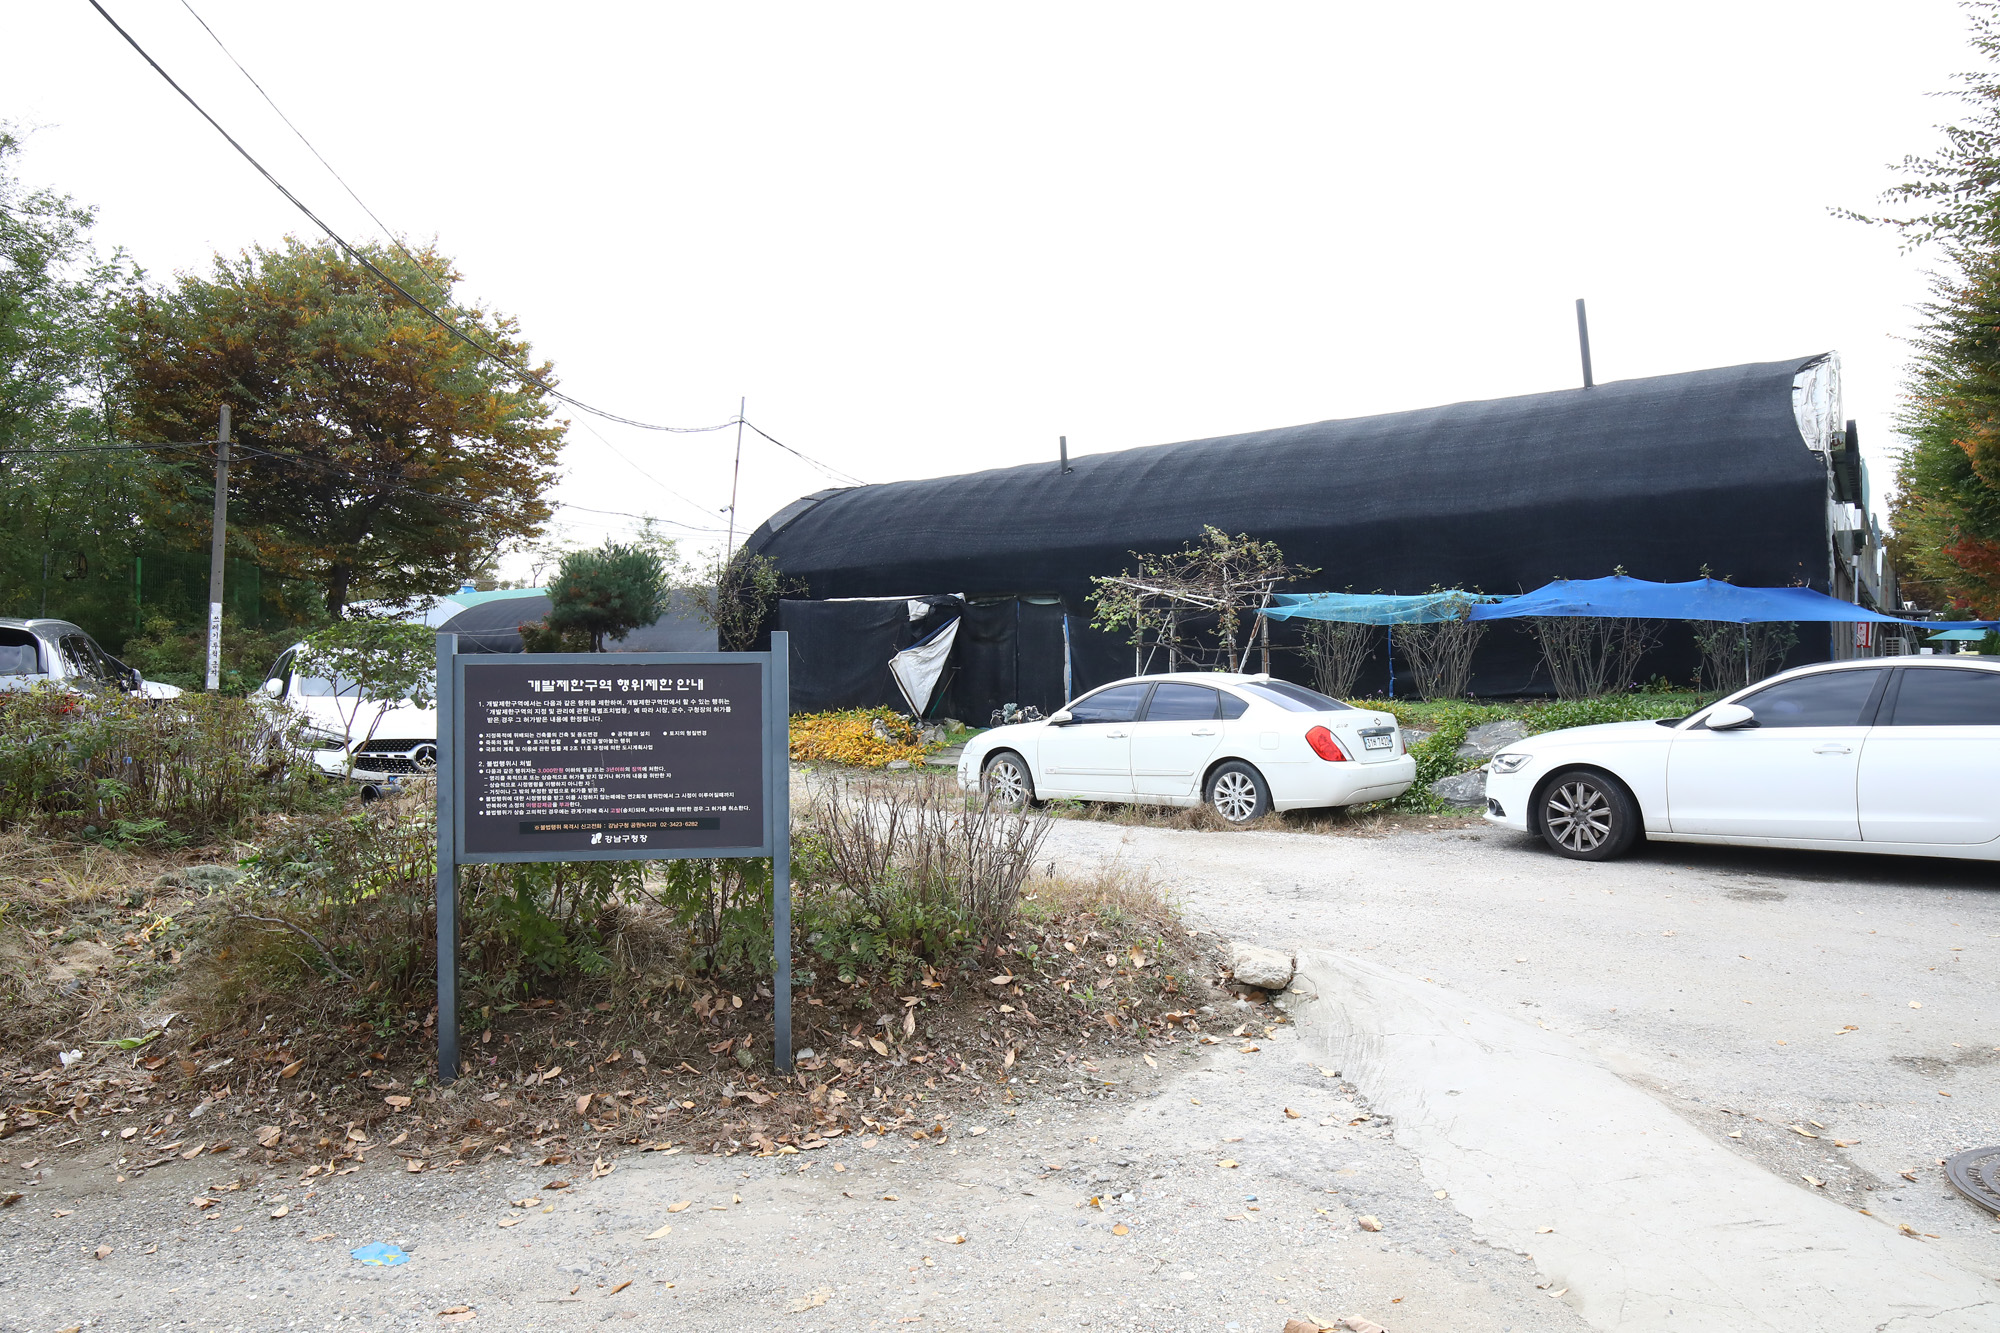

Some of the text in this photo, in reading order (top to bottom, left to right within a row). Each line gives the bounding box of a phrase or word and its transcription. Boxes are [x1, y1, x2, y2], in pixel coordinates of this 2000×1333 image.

[212, 616, 220, 639] 쓰레기
[211, 661, 219, 676] 금지
[528, 679, 704, 691] 개발제한구역 행위제한 안내
[604, 835, 648, 843] 강남구청장
